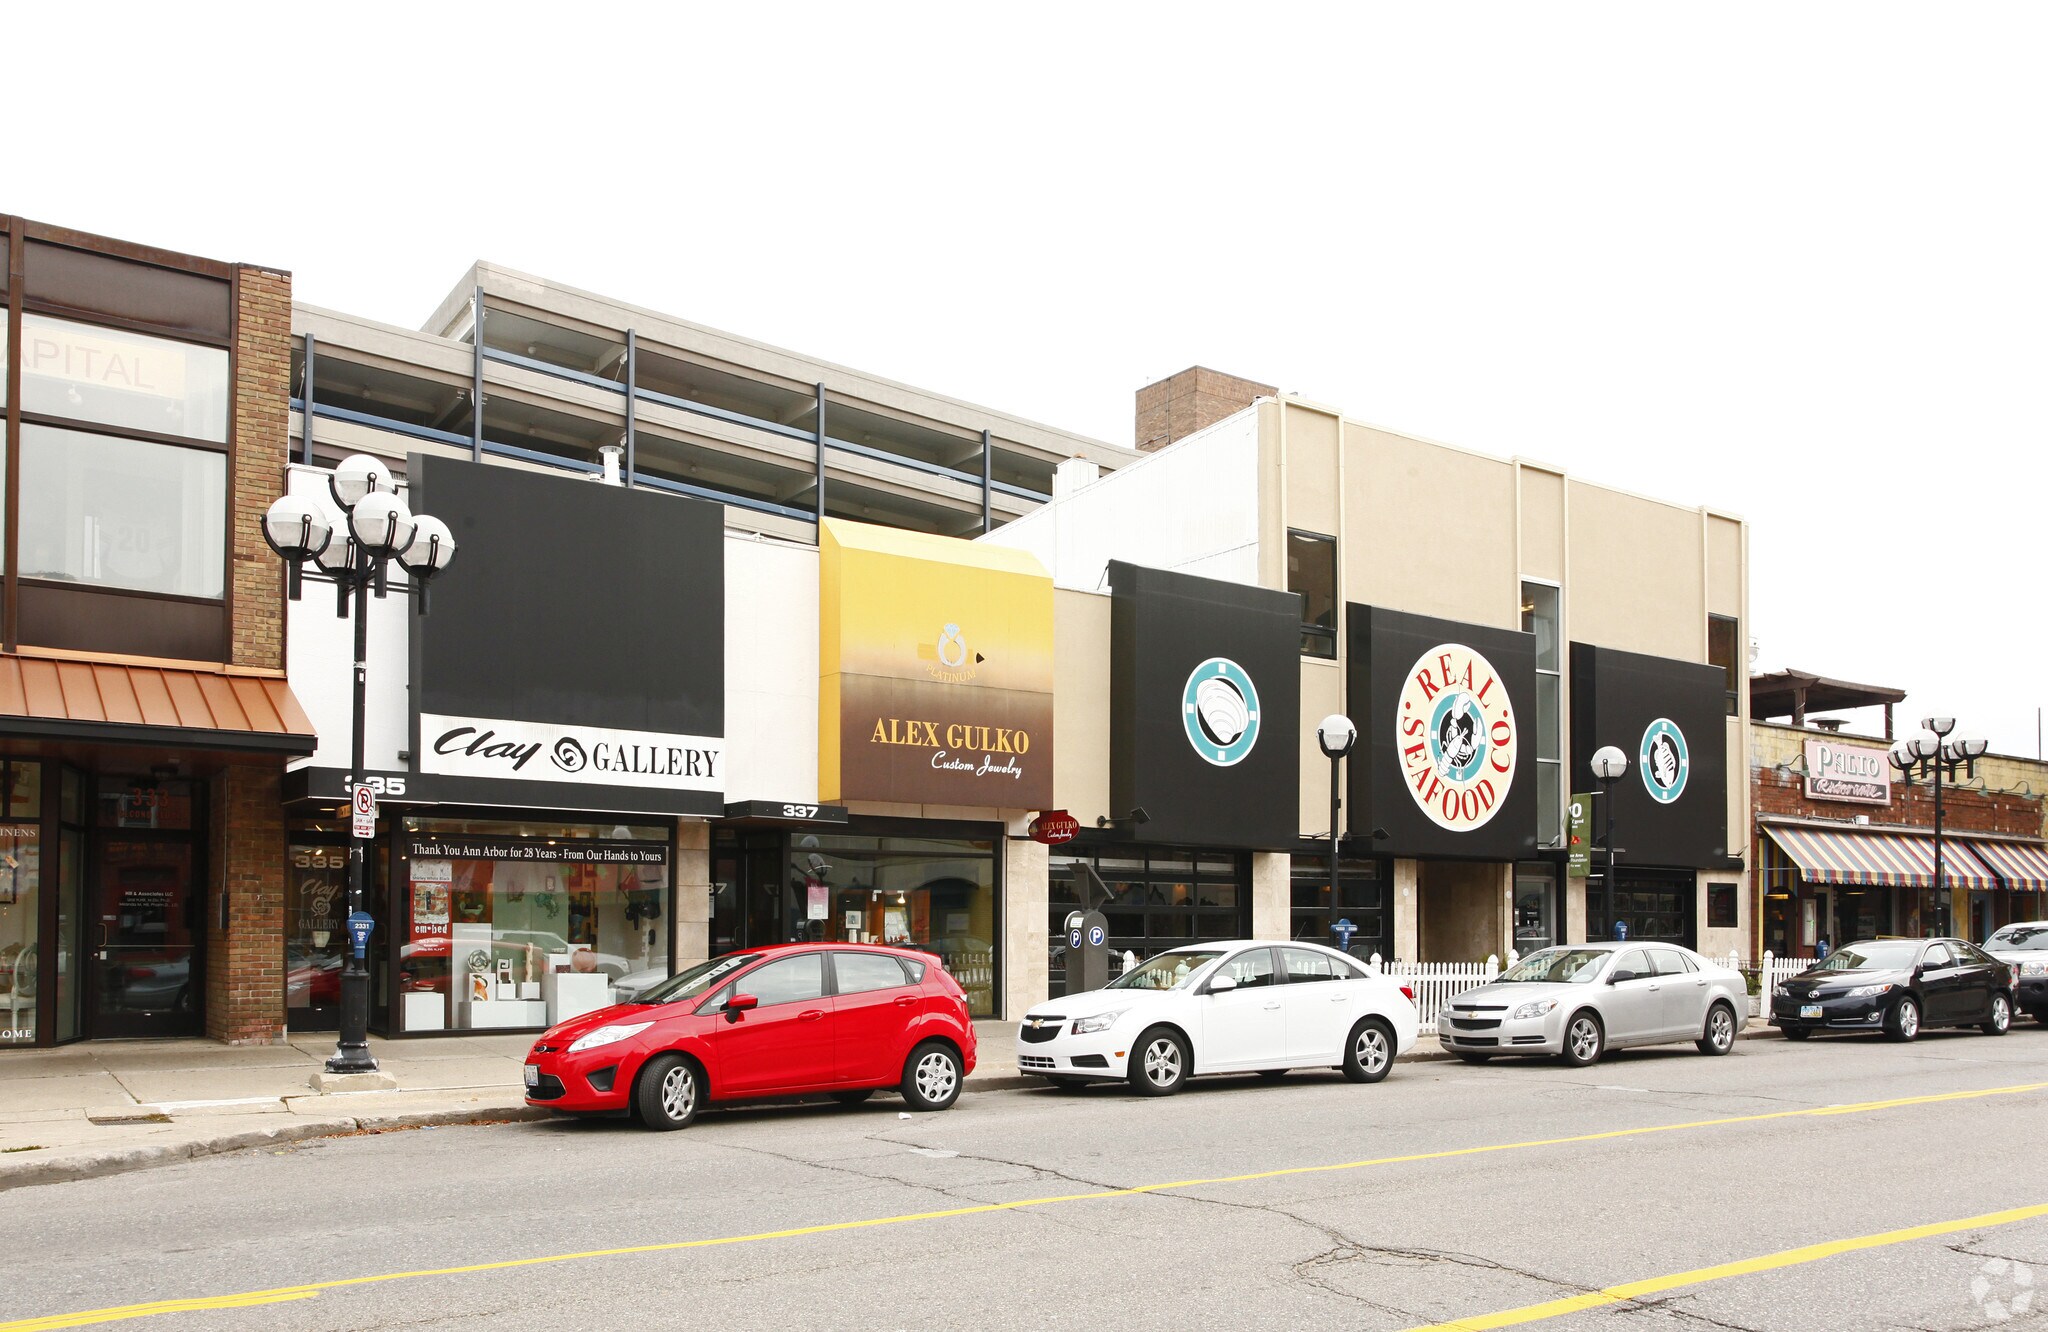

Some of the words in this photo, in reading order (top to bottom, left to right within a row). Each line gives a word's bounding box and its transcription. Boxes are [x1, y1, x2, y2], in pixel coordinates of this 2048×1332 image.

[925, 664, 977, 682] PLATINUM
[1415, 653, 1495, 709] REAL
[870, 717, 941, 748] ALEX
[946, 723, 1030, 755] GULKO
[433, 726, 543, 771] Clay
[593, 742, 719, 778] GALLERY
[931, 750, 975, 771] Custom
[976, 754, 1022, 779] Jewelry
[1403, 716, 1495, 822] SEAFOOD
[132, 787, 169, 807] 333
[1816, 778, 1884, 798] Ristorante
[783, 804, 819, 818] 337
[1041, 821, 1056, 830] ALEX
[1056, 820, 1077, 829] GULKO
[295, 855, 344, 869] 335
[412, 843, 441, 855] Thank
[443, 844, 460, 856] You
[462, 845, 481, 857] Ann
[483, 845, 508, 857] Arbor
[510, 846, 522, 858] for
[524, 847, 533, 858] 28
[535, 847, 557, 859] Years
[563, 848, 584, 860] From
[586, 849, 602, 860] Our
[604, 849, 629, 861] Hands
[630, 850, 638, 861] to
[640, 850, 662, 862] Yours
[300, 878, 339, 902] Clay
[299, 918, 340, 930] GALLERY
